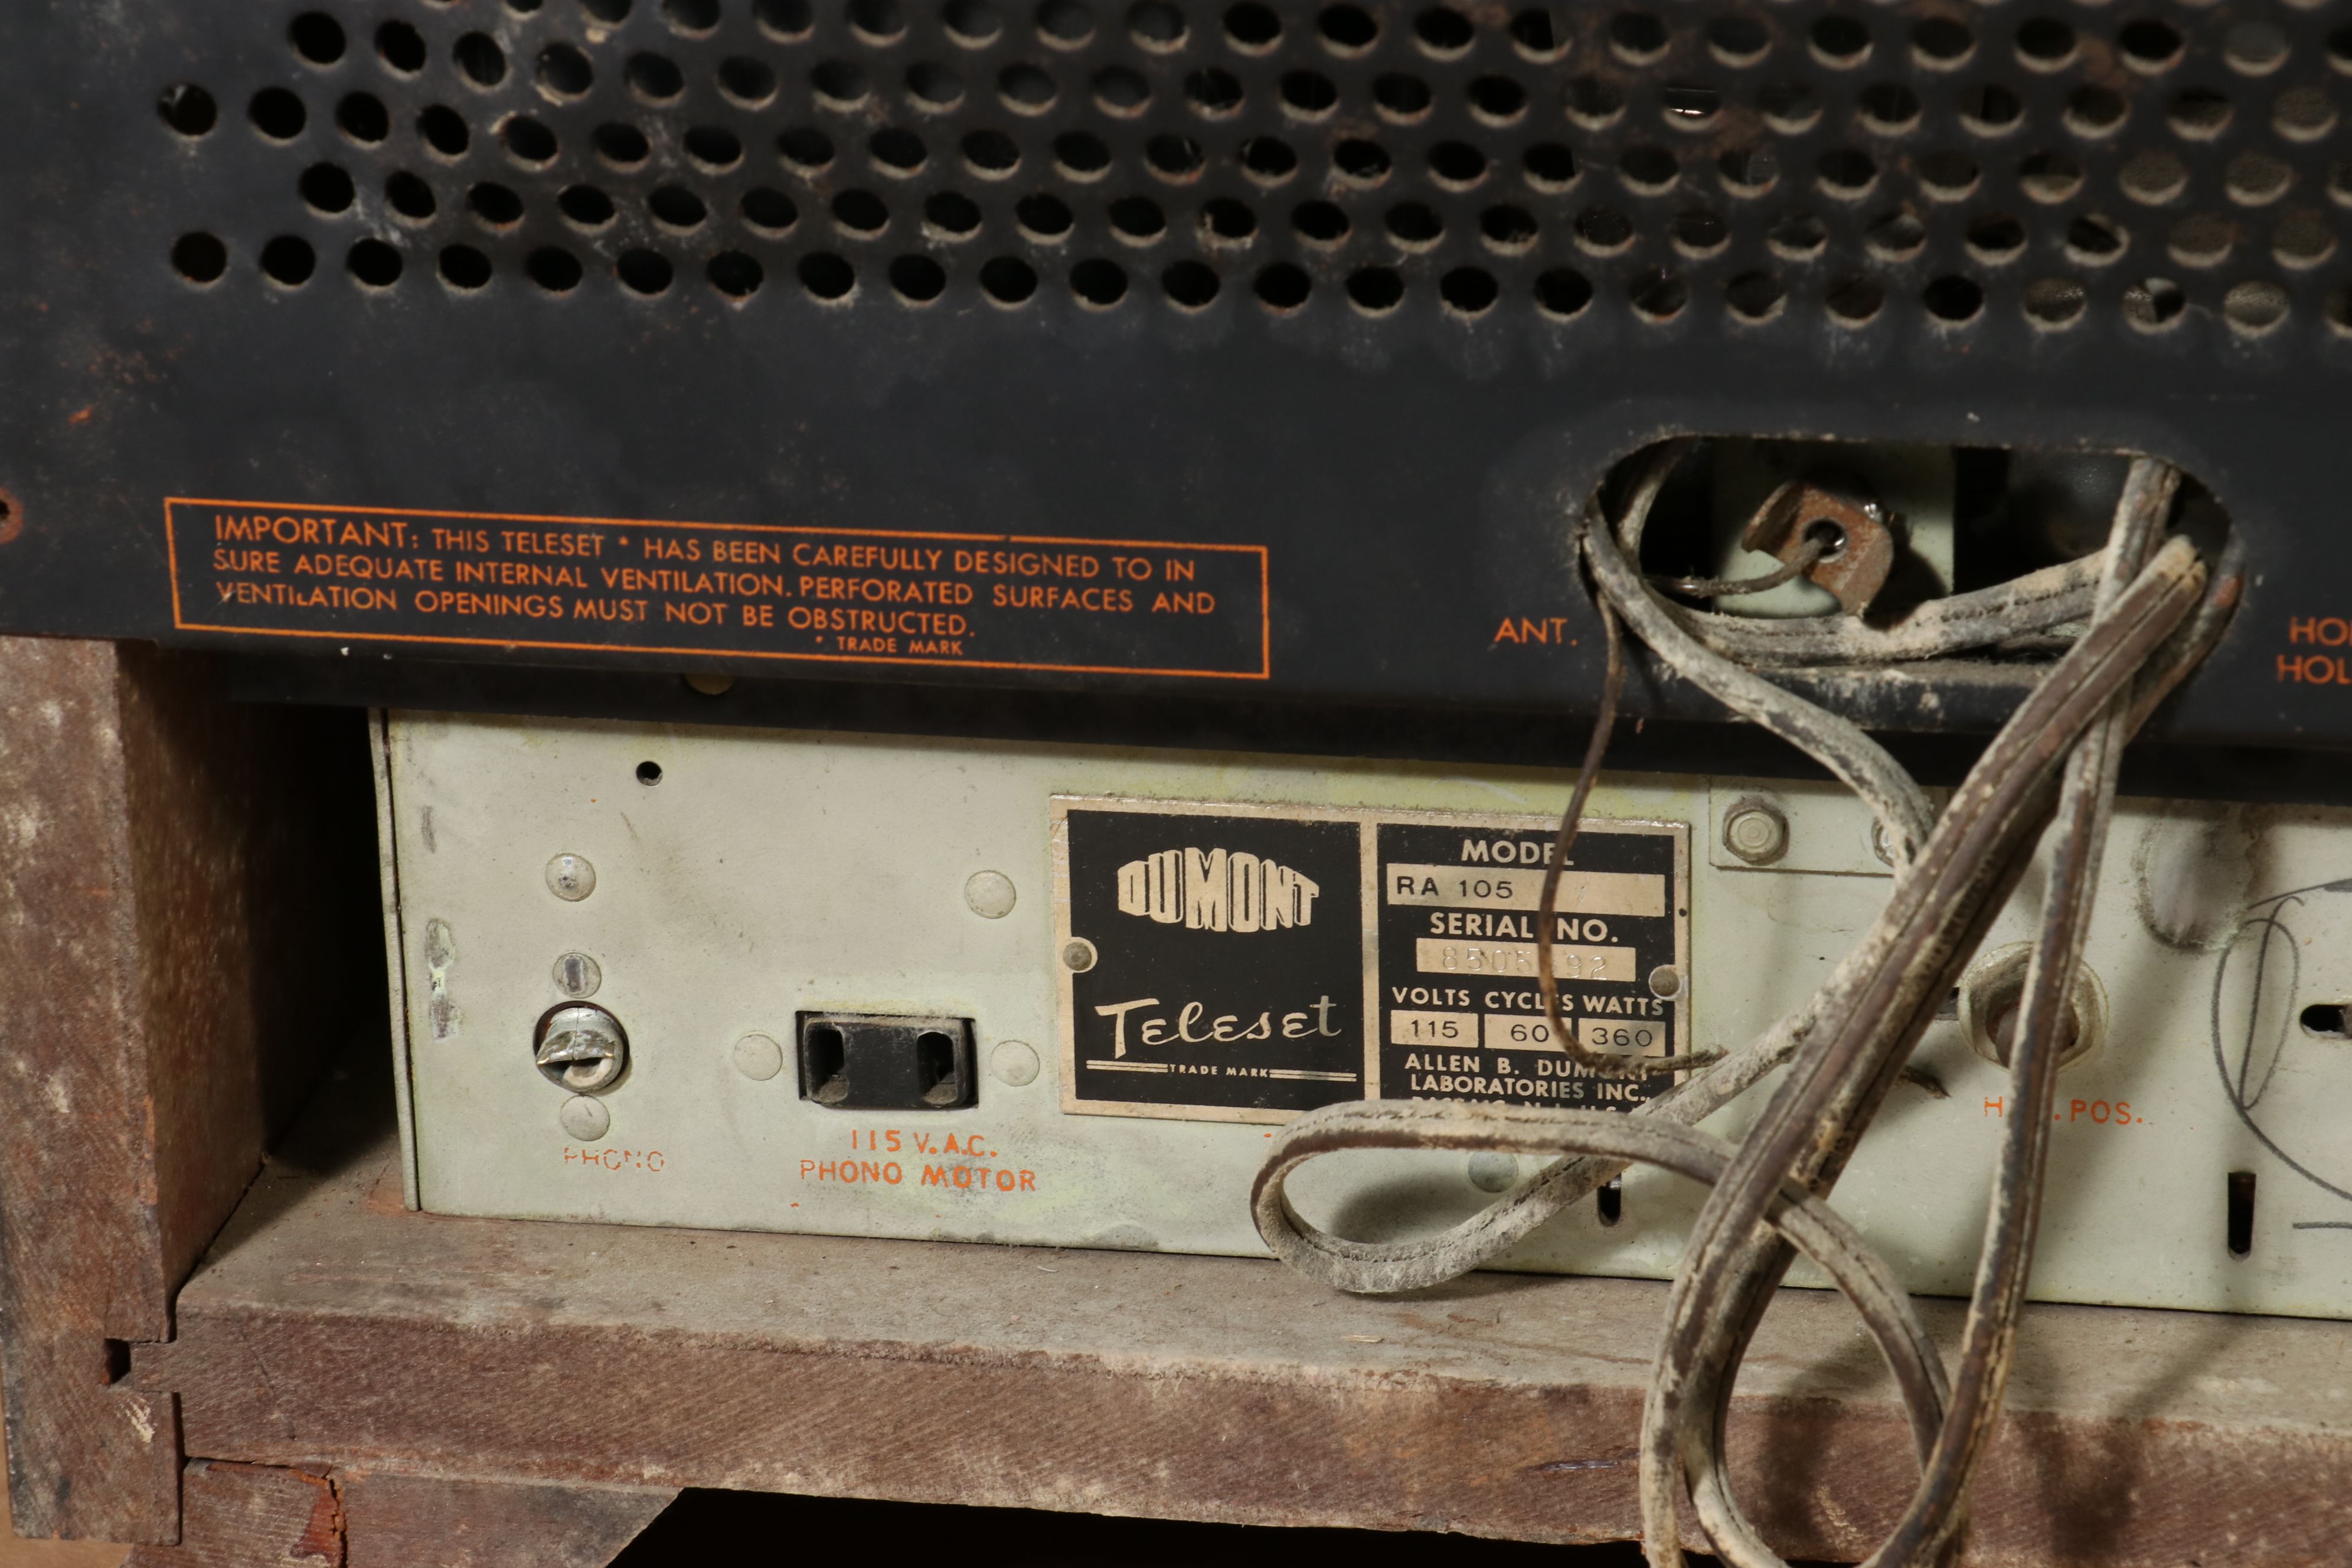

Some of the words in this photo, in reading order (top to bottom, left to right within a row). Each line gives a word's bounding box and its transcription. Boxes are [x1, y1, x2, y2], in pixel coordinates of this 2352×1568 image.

[214, 514, 419, 548] IMPORTANT:
[432, 528, 491, 553] THIS
[501, 531, 605, 557] TELESET
[643, 538, 702, 561] HAS
[713, 540, 781, 564] BEEN
[793, 543, 943, 571] CAREFULLY
[954, 550, 1100, 579] DESIGNED
[1112, 556, 1152, 581] TO
[1165, 560, 1195, 582] IN
[213, 548, 280, 574] SURE
[293, 553, 444, 582] ADEQUATE
[455, 561, 589, 589] INTERNAL
[600, 567, 792, 597] VENTILATION.
[799, 576, 974, 605] PERFORATED
[992, 583, 1133, 612] SURFACES
[1152, 592, 1216, 614] AND
[216, 582, 397, 610] VENTILATION
[414, 590, 564, 619] OPENINGS
[573, 598, 649, 622] MUST
[665, 602, 727, 625] NOT
[742, 605, 774, 628] BE
[788, 606, 976, 637] OBSTRUCTED.
[837, 635, 897, 654] TRADE
[909, 639, 963, 656] MARK
[1494, 618, 1577, 646] ANT.
[2289, 618, 2352, 646] HO
[1118, 847, 1319, 933] DUMONT
[1396, 876, 1439, 896] RA
[1459, 879, 1513, 899] 105
[1430, 912, 1534, 939] SERIAL
[1557, 918, 1619, 943] NO.
[1443, 946, 1607, 980] 850592
[1391, 986, 1470, 1007] VOLTS
[1485, 991, 1574, 1011] CYCLS
[1582, 995, 1664, 1017] WATTS
[1411, 1020, 1459, 1038] 115
[1511, 1024, 1550, 1043] 60
[1592, 1027, 1653, 1047] 360
[1168, 1063, 1218, 1076] TRADE
[1226, 1067, 1269, 1078] MARK
[1404, 1053, 1481, 1073] ALLEN
[1497, 1057, 1520, 1076] B.
[1411, 1074, 1585, 1099] LABORATORIES
[2071, 1100, 2142, 1125] POS.
[852, 1130, 901, 1152] 115
[801, 1160, 902, 1184] PHONO
[921, 1165, 1035, 1191] MOTOR
